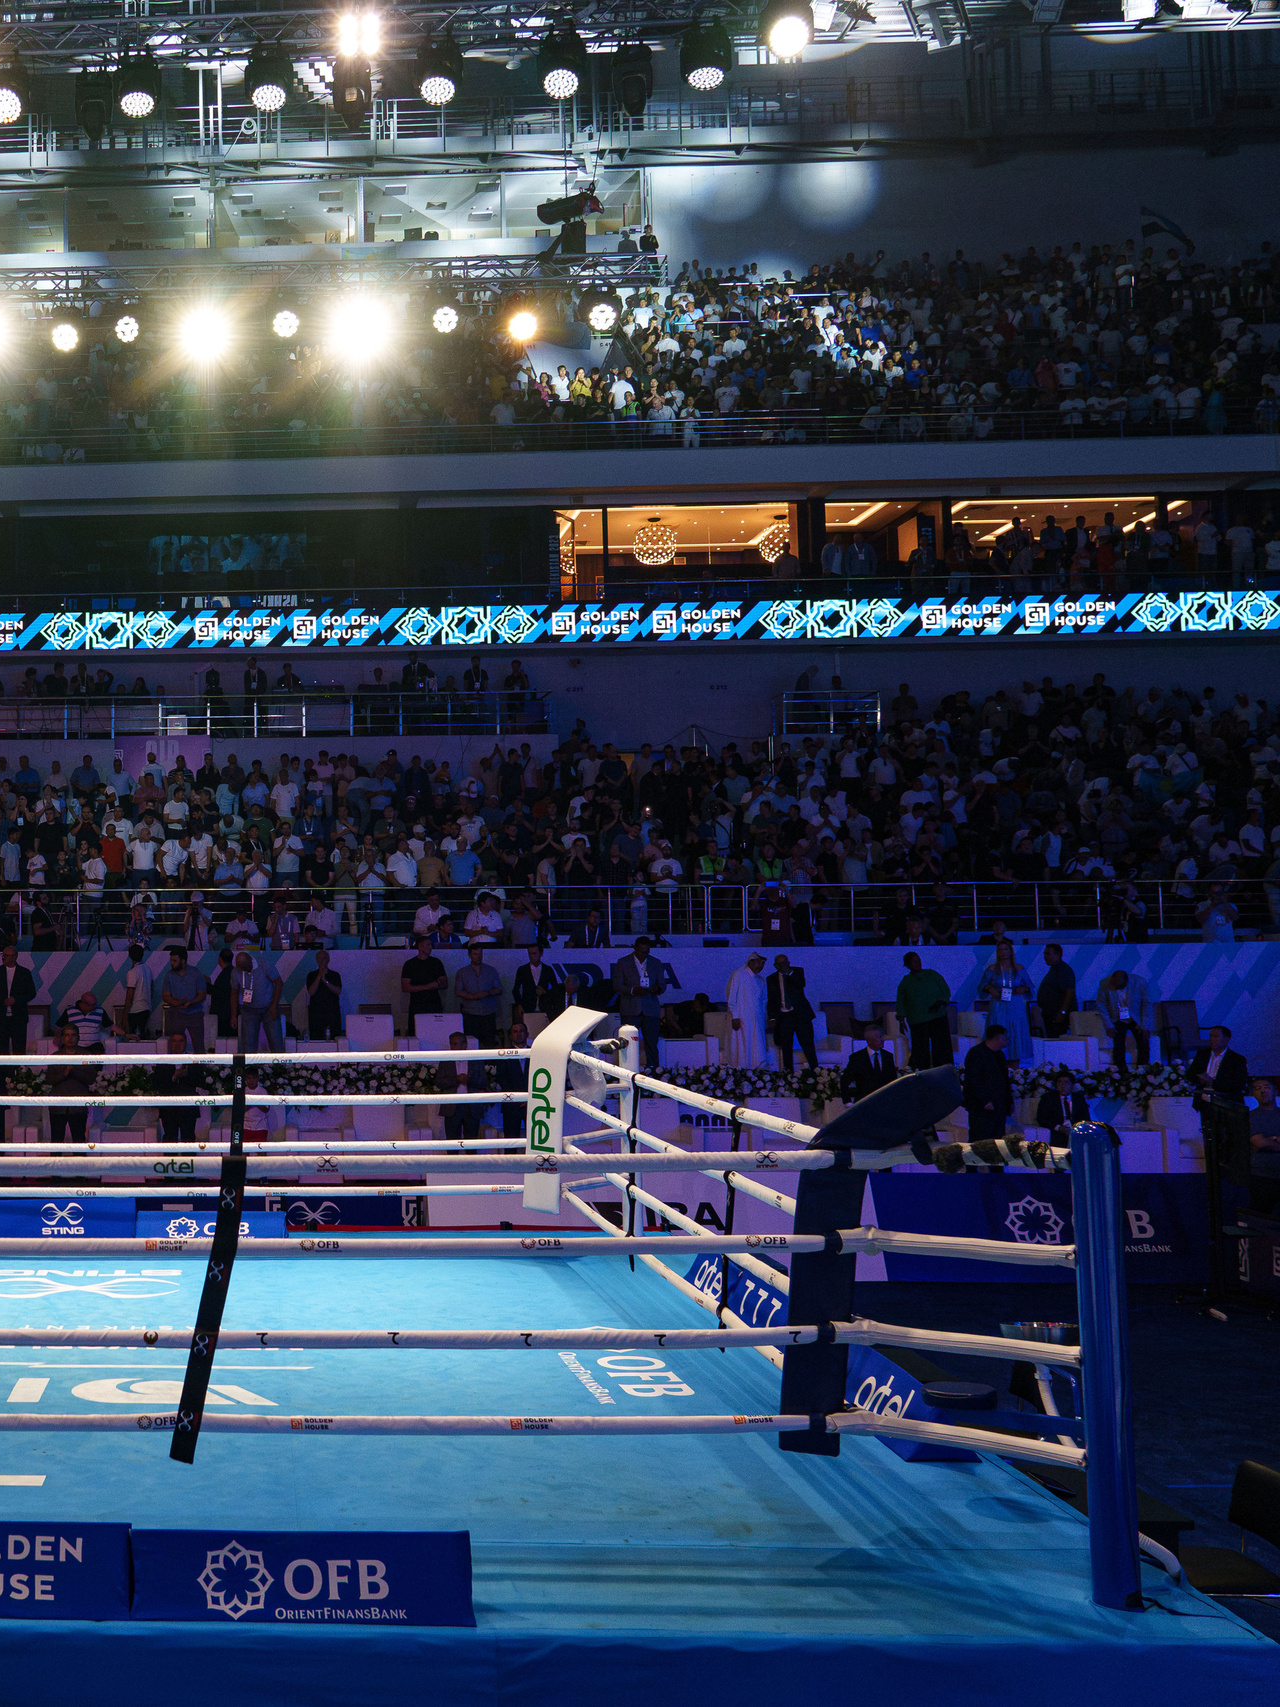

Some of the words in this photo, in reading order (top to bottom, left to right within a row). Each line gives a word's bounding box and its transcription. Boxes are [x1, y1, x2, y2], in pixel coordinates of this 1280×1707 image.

[951, 604, 1011, 615] GOLDEN
[1055, 602, 1115, 613] GOLDEN
[581, 611, 639, 622] GOLDEN
[681, 609, 740, 620] GOLDEN
[223, 617, 280, 627] GOLDEN
[322, 616, 379, 626] GOLDEN
[951, 618, 1001, 629] HOUSE
[1055, 616, 1105, 627] HOUSE
[322, 629, 369, 639] HOUSE
[581, 625, 629, 635] HOUSE
[681, 623, 730, 634] HOUSE
[223, 630, 269, 640] HOUSE
[531, 1068, 556, 1152] artel
[153, 1159, 194, 1174] artel
[41, 1226, 85, 1236] STING
[203, 1221, 250, 1235] OB
[317, 1241, 340, 1249] OFB
[538, 1239, 561, 1247] OFB
[763, 1237, 787, 1245] OFB
[596, 1355, 695, 1397] OFB
[154, 1416, 177, 1426] OFB
[283, 1559, 389, 1601] OFB
